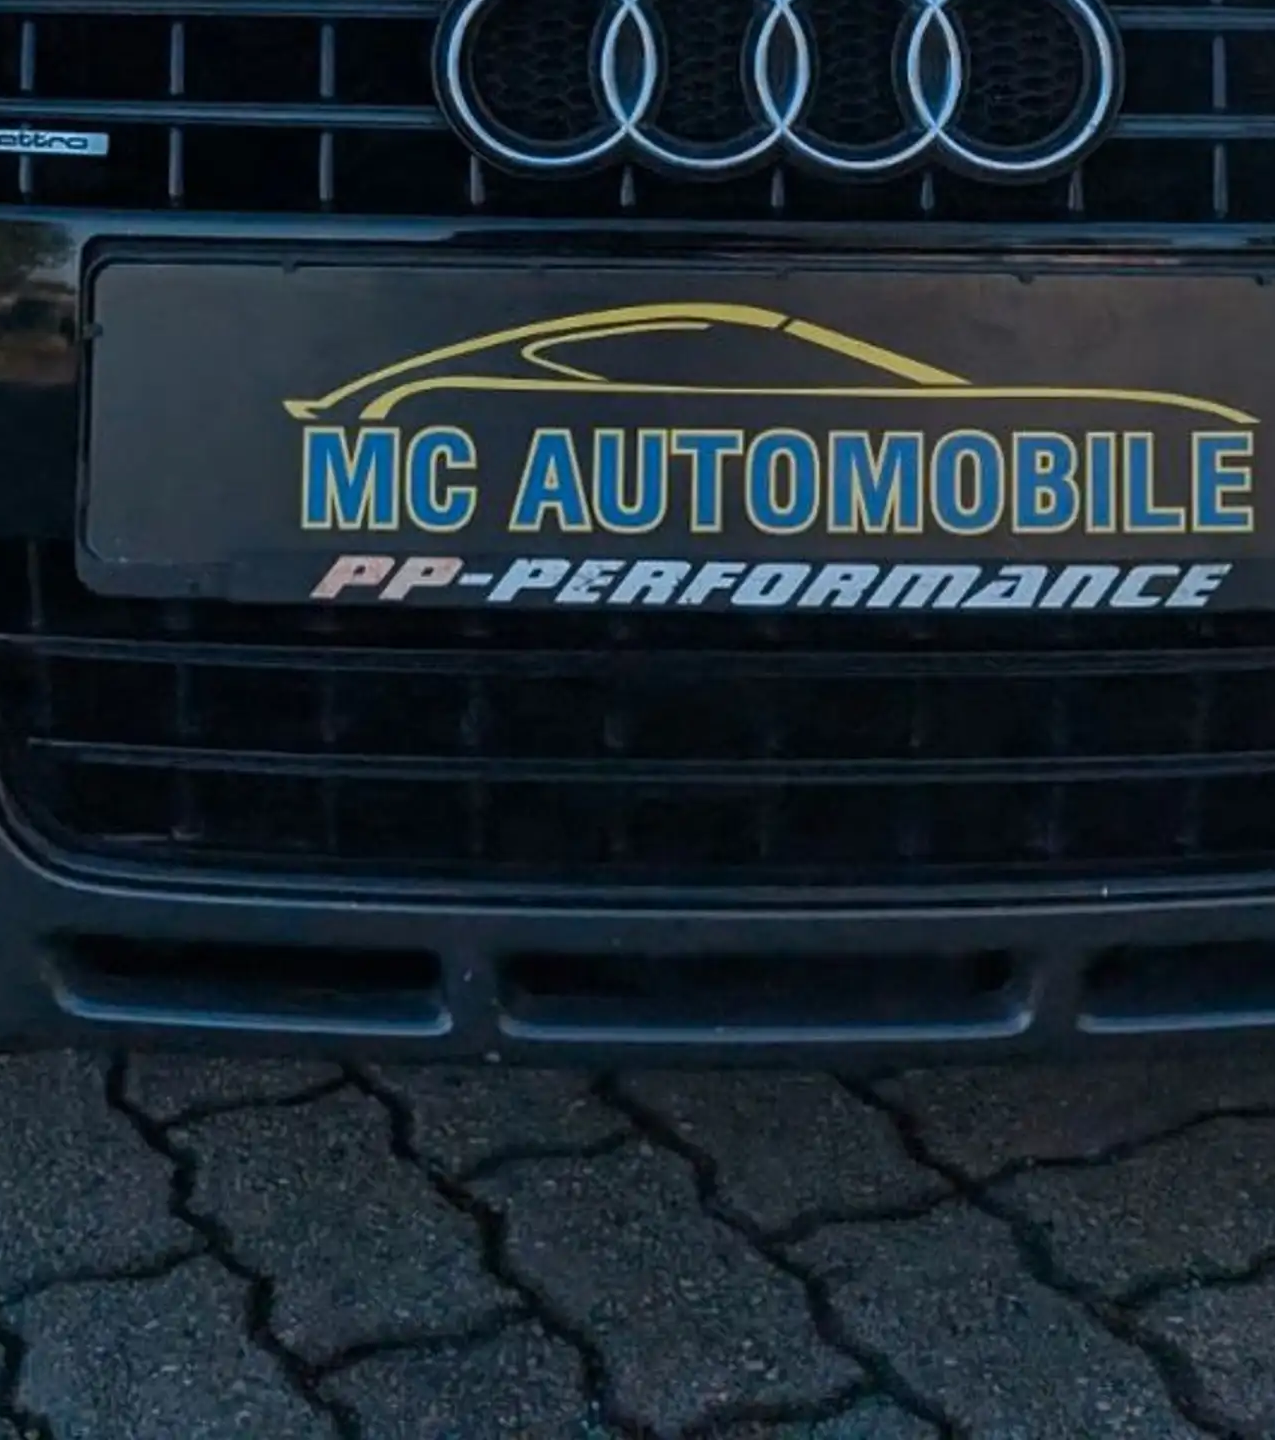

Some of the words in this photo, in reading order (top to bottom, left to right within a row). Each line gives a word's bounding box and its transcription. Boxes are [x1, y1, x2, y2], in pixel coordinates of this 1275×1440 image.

[301, 425, 478, 533] MC
[508, 427, 1255, 535] AUTOMOBILE
[309, 555, 1233, 609] PP-PERFORMANCE
